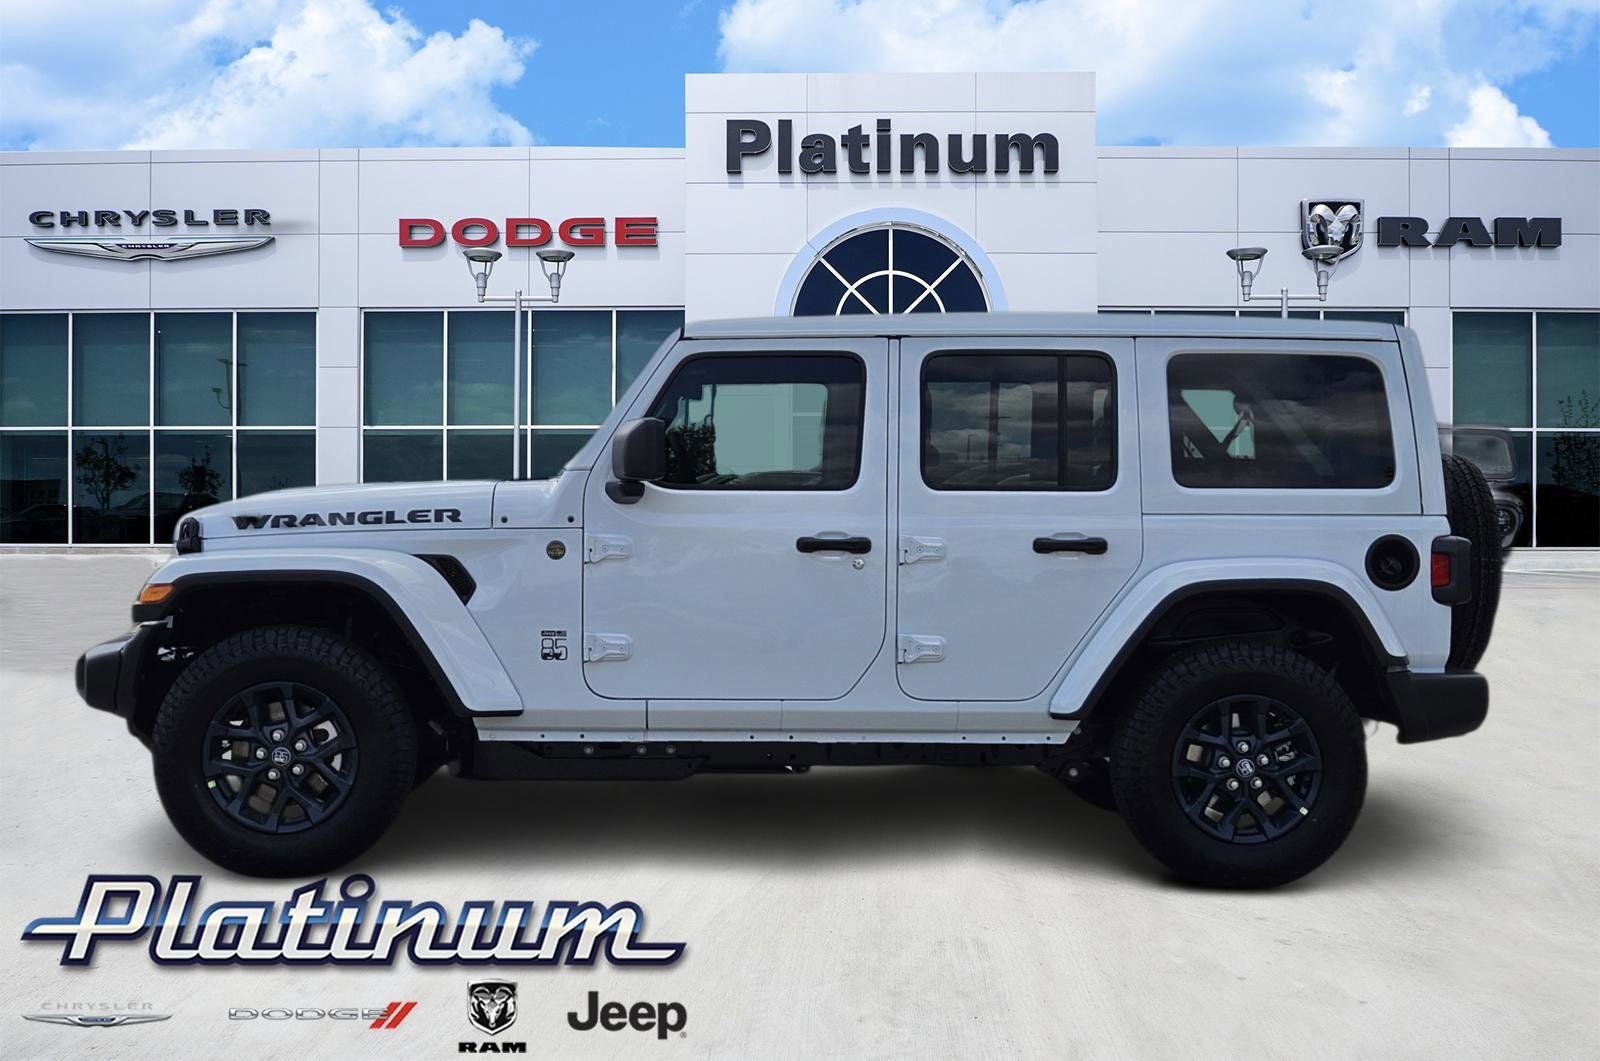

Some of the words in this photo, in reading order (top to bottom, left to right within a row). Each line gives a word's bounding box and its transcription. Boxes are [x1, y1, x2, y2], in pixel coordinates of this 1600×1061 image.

[726, 118, 1060, 175] Platinum
[28, 208, 272, 227] CHRYSLER
[399, 216, 658, 248] DODGE
[1377, 216, 1563, 249] RAM
[231, 508, 464, 530] WRANGLER
